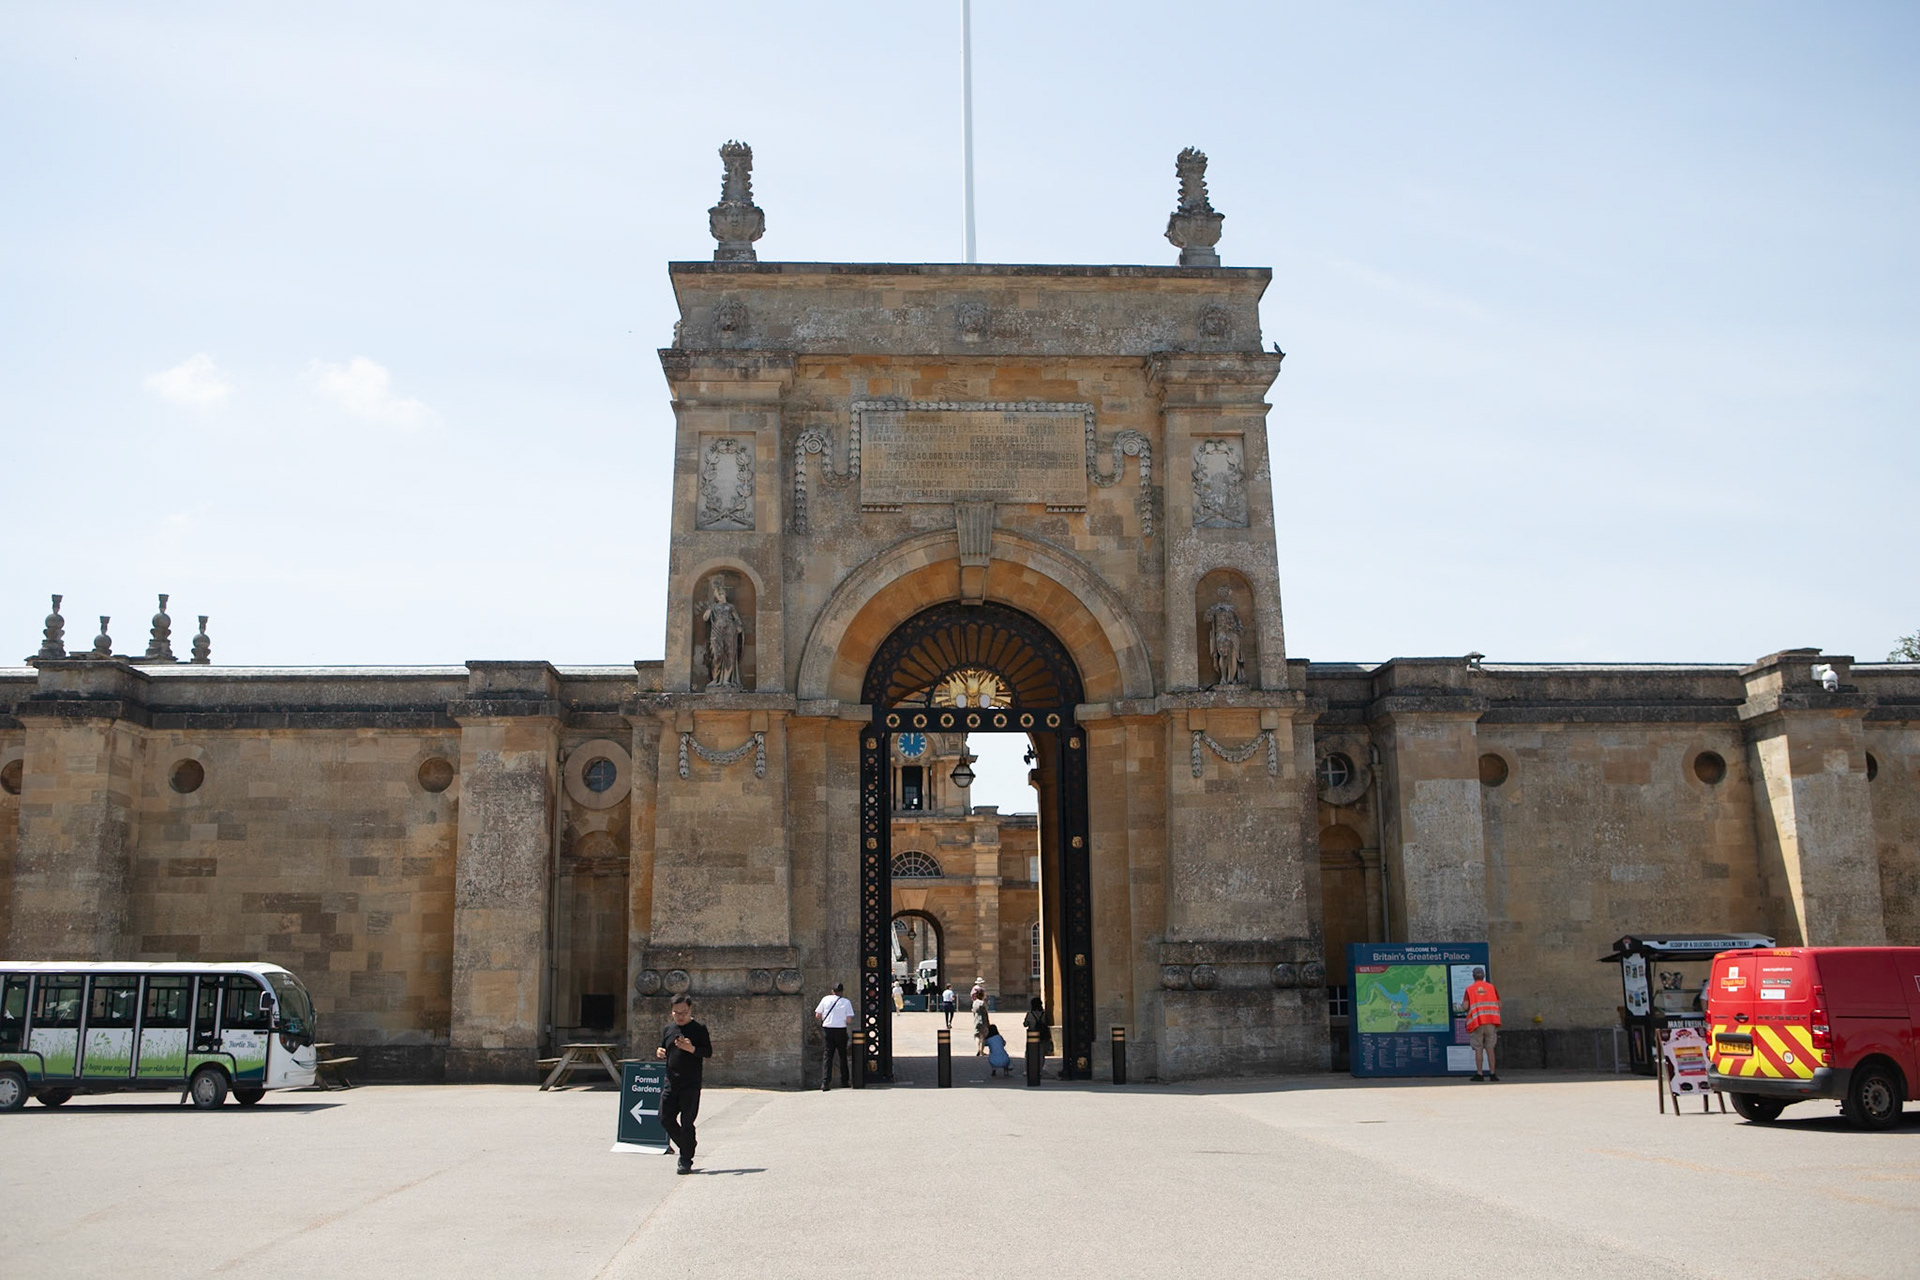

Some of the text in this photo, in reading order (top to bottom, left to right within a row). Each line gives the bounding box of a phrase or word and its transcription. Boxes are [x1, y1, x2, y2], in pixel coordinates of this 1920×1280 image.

[1372, 952, 1470, 961] Britain's Greatest Palace
[631, 1084, 661, 1093] Gardens
